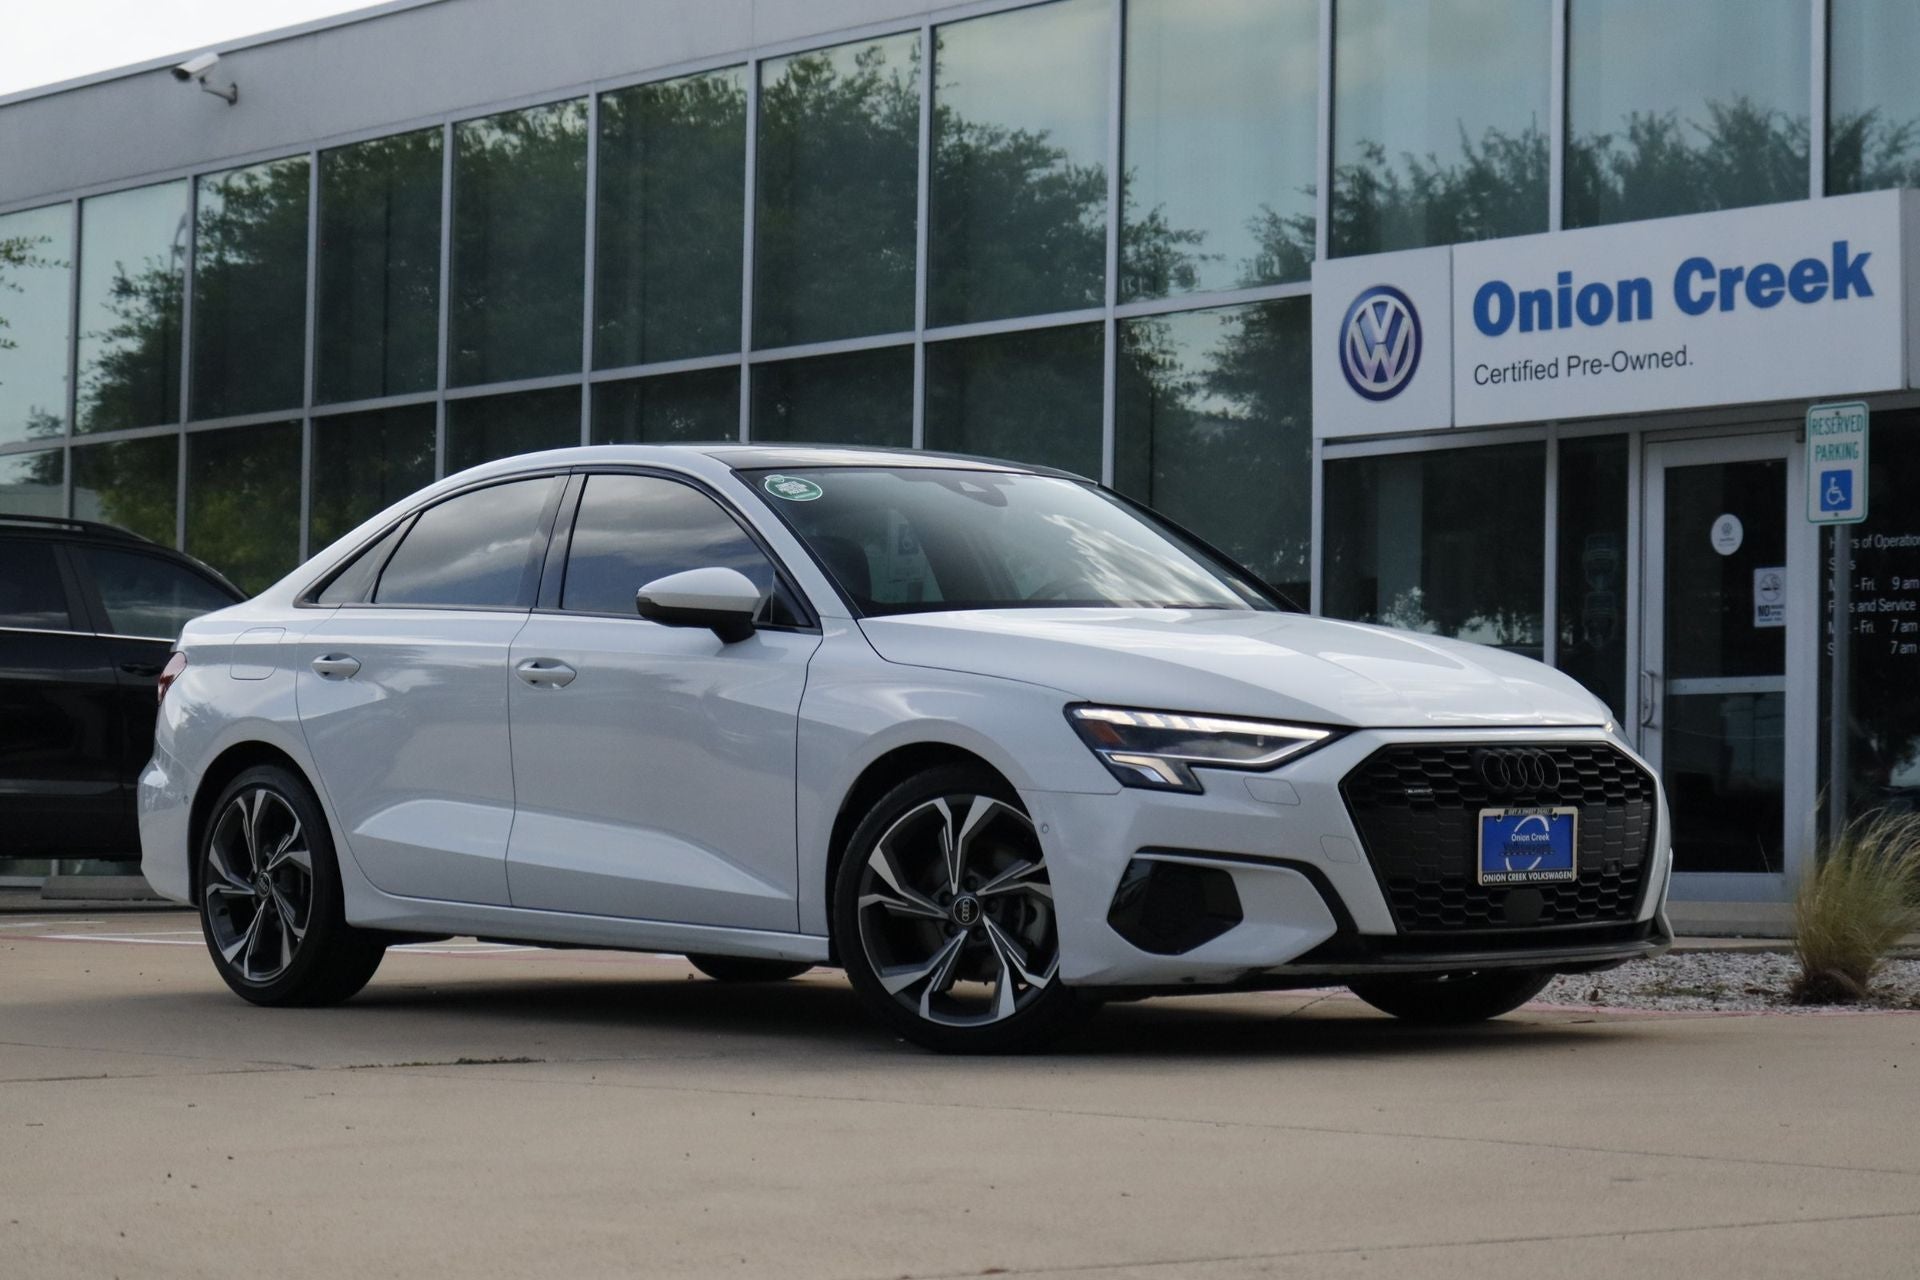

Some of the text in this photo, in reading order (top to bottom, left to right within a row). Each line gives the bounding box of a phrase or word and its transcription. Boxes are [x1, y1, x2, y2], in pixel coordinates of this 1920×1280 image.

[1473, 240, 1875, 337] Onion Creek
[1473, 345, 1693, 386] Certified Pre-Owned.
[1812, 414, 1864, 435] RESERVED
[1815, 441, 1859, 461] PARKING
[1862, 534, 1872, 548] of
[1874, 533, 1920, 550] Operatio
[1892, 576, 1901, 590] 9
[1902, 578, 1919, 590] am
[1758, 604, 1770, 617] NO
[1857, 599, 1877, 612] and
[1878, 598, 1916, 612] Service
[1891, 619, 1899, 633] 7
[1900, 622, 1918, 633] am
[1890, 640, 1918, 655] 7 am
[1511, 832, 1550, 842] Onion Creek
[1483, 871, 1572, 882] ONION CREEK VOLKSWAGEN
